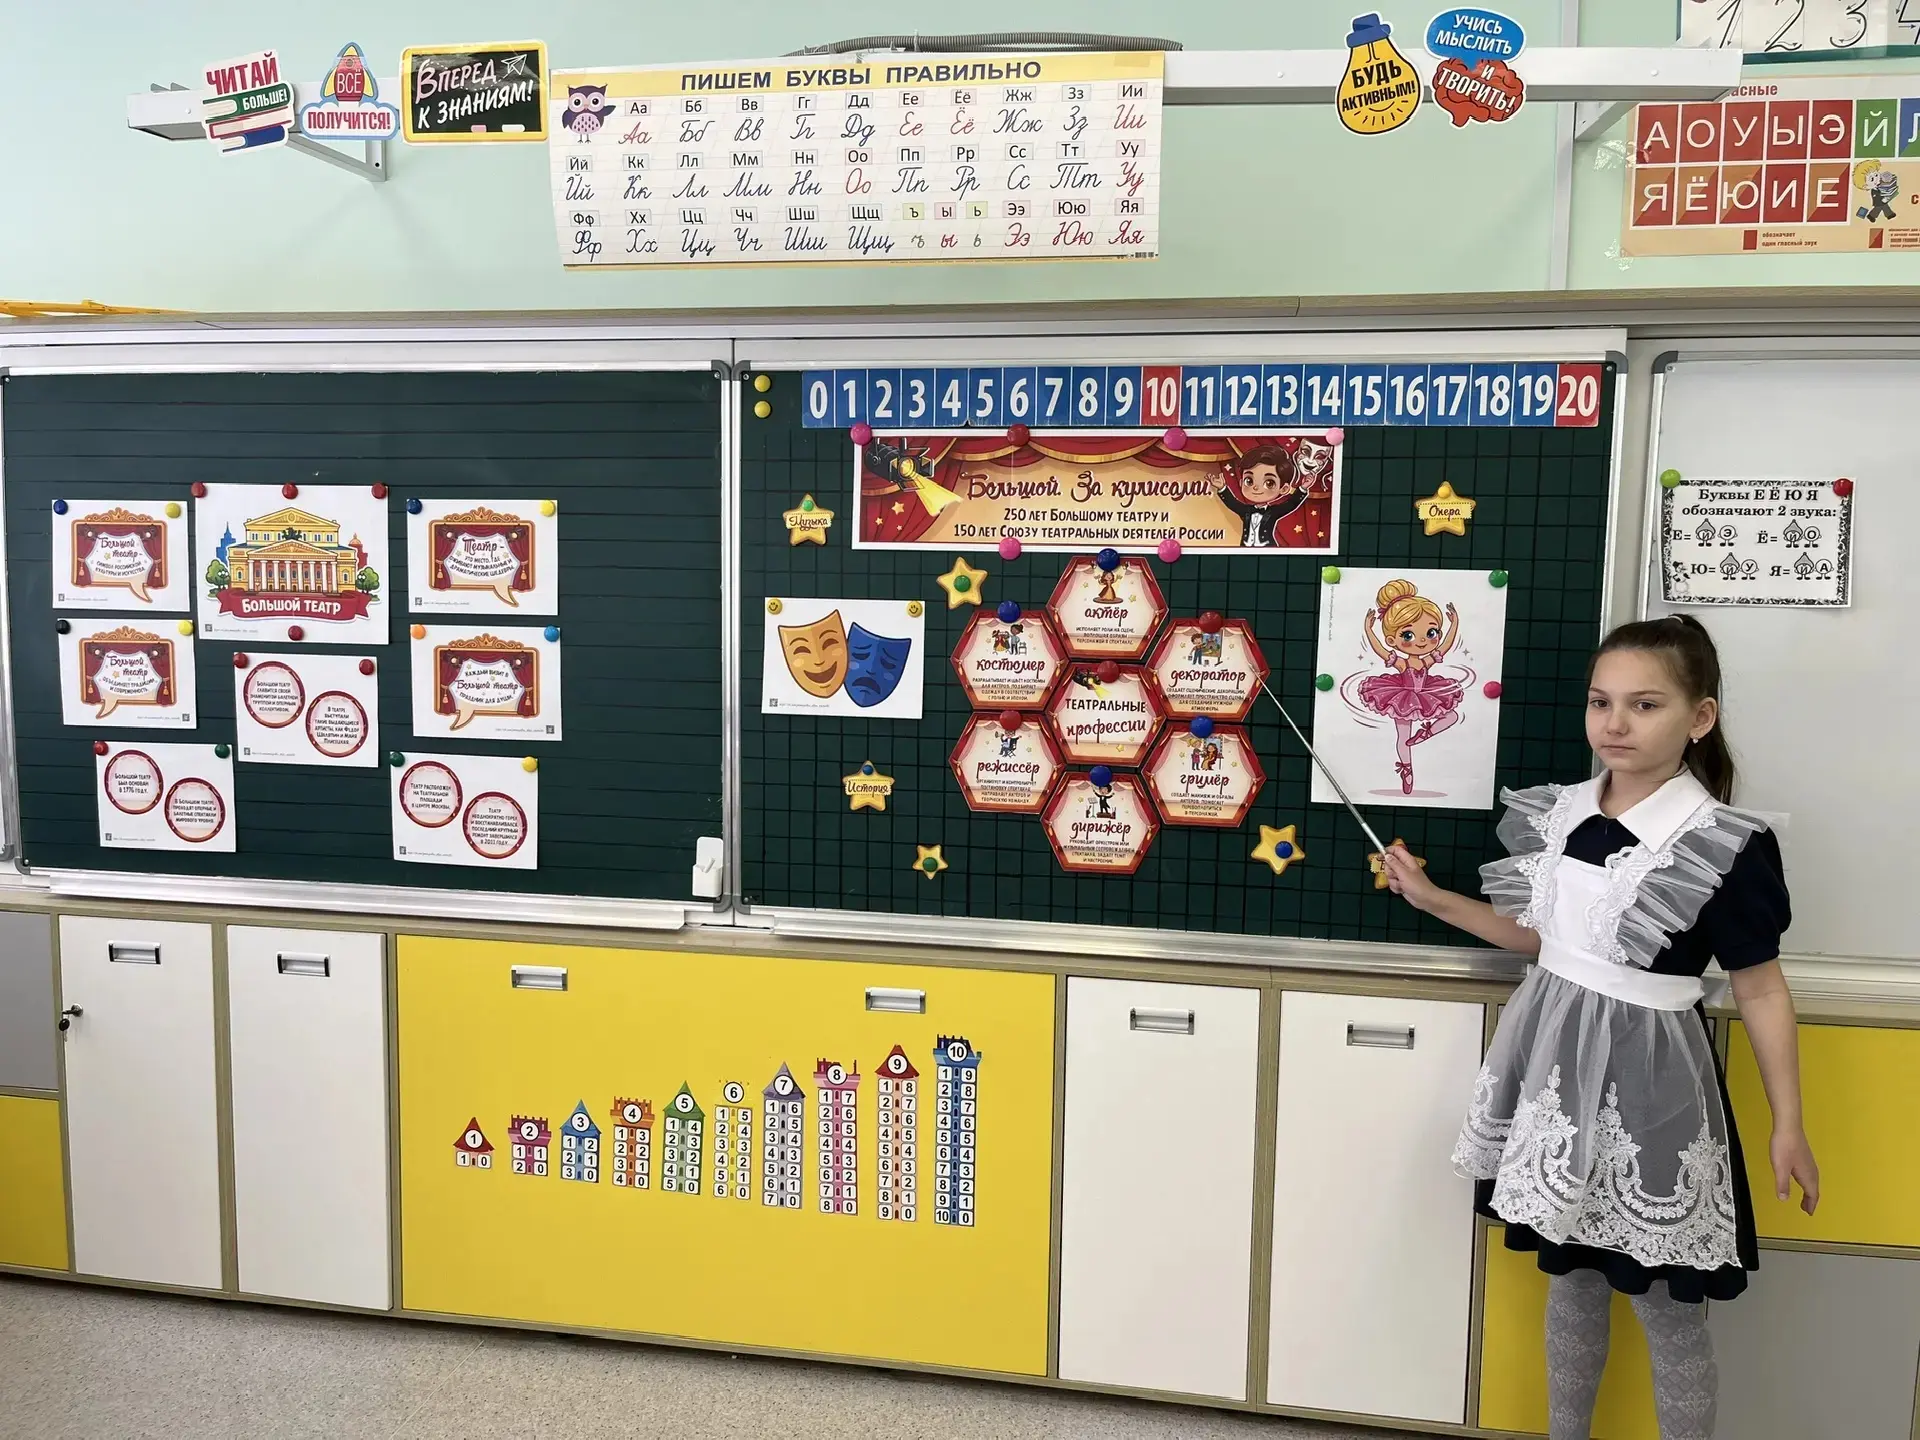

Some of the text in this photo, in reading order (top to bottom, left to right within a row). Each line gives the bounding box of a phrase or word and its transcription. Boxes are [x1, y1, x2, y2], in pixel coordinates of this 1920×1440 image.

[1453, 14, 1502, 35] УЧИСЬ
[1717, 0, 1741, 48] 1
[1764, 0, 1804, 52] 2
[1830, 0, 1867, 47] 3
[1435, 30, 1513, 54] МЫСЛИТЬ
[207, 51, 279, 95] ЧИТАЙ
[337, 68, 362, 94] ВСЁ
[681, 61, 1041, 91] ПИШЕМ БУКВЫ ПРАВИЛЬНО
[1351, 60, 1401, 88] БУДЬ
[1481, 65, 1495, 81] И
[243, 89, 288, 112] БОЛЬШЕ!
[630, 86, 1143, 115] Аа Бб Вв Гг Дд Ее Ёё Жж Зз Ии
[1342, 81, 1416, 112] АКТИВНЫМ!
[1437, 67, 1516, 113] ТВОРИТЬ!
[1727, 84, 1779, 96] асные
[418, 80, 534, 129] К ЗНАНИЯМ!
[307, 111, 391, 131] ПОЛУЧИТСЯ!
[1644, 121, 1671, 150] А
[1686, 119, 1716, 148] О
[1732, 116, 1758, 147] У
[1772, 115, 1803, 146] Ы
[1818, 114, 1845, 145] Э
[1863, 110, 1888, 147] Й
[1641, 176, 1840, 212] Я Ё Ю И Е
[809, 375, 1597, 419] 0 1 2 3 4 5 6 7 8 9 10 11 12 13 14 15 16 17 18 19 20
[960, 470, 1213, 504] Большой. За кулисами.
[1698, 487, 1818, 502] Буквы Е Ё Ю Я
[1004, 508, 1169, 523] 250 ЛЕТ БОЛЬШОМУ ТЕАТРУ И
[1428, 503, 1461, 522] Опера
[1682, 505, 1836, 518] обозначают 2 звука:
[789, 514, 830, 531] Музыка
[954, 524, 1224, 539] 150 ЛЕТ СОЮЗУ ТЕАТРАЛЬНЫХ ДЕЯТЕЛЕЙ РОССИИ
[242, 598, 341, 615] БОЛЬШОЙ ТЕАТР
[1085, 606, 1128, 627] актёр
[976, 657, 1045, 679] костюмер
[1171, 668, 1245, 689] декоратор
[1066, 699, 1146, 713] ТЕАТРАЛЬНЫЕ
[1067, 718, 1146, 745] профессии
[976, 759, 1040, 780] режиссёр
[847, 780, 889, 797] История
[1180, 773, 1229, 795] гримёр
[1072, 820, 1131, 843] дирижёр
[949, 1046, 964, 1058] 10
[833, 1069, 840, 1080] 8
[893, 1058, 901, 1070] 9
[730, 1086, 737, 1098] 6
[780, 1079, 787, 1091] 7
[628, 1108, 636, 1119] 4
[681, 1098, 688, 1109] 5
[526, 1126, 533, 1136] 2
[577, 1117, 584, 1128] 3
[471, 1134, 477, 1144] 1
